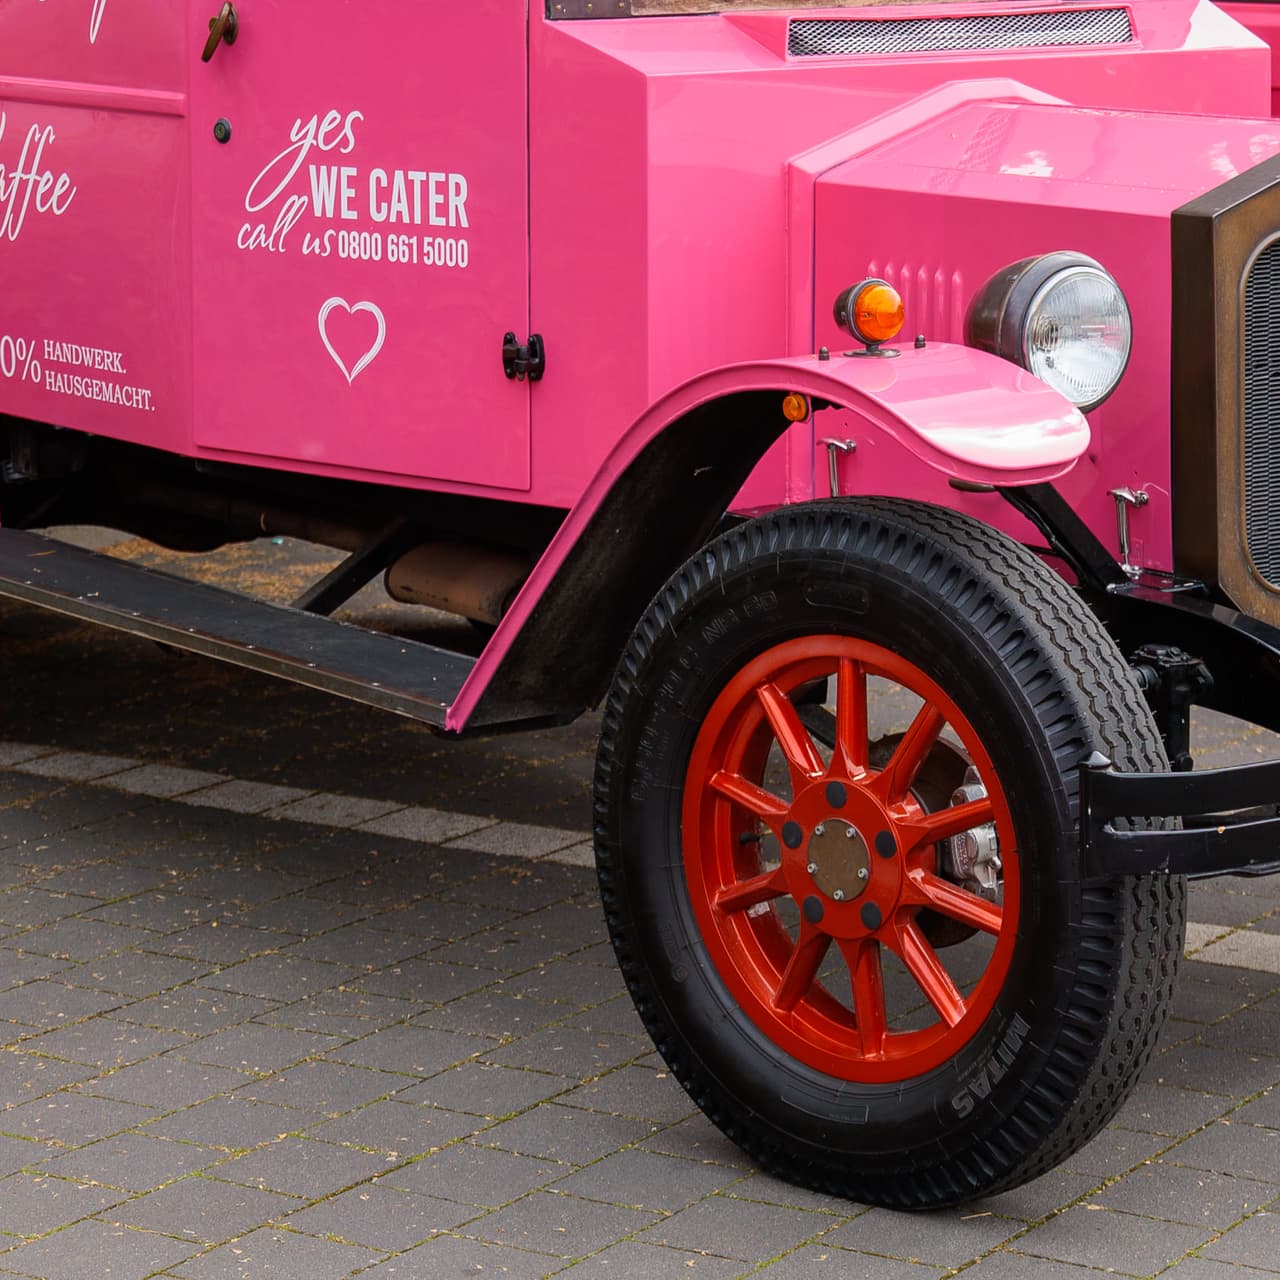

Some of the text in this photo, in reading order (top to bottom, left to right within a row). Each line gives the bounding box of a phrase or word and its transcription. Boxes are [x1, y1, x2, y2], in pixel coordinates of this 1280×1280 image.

[245, 109, 364, 213] yes
[309, 163, 469, 228] WE CATER
[237, 195, 469, 268] call us 0800 661 5000
[43, 338, 128, 375] HANDWERK.
[45, 371, 156, 413] HAUSGEMACHT.
